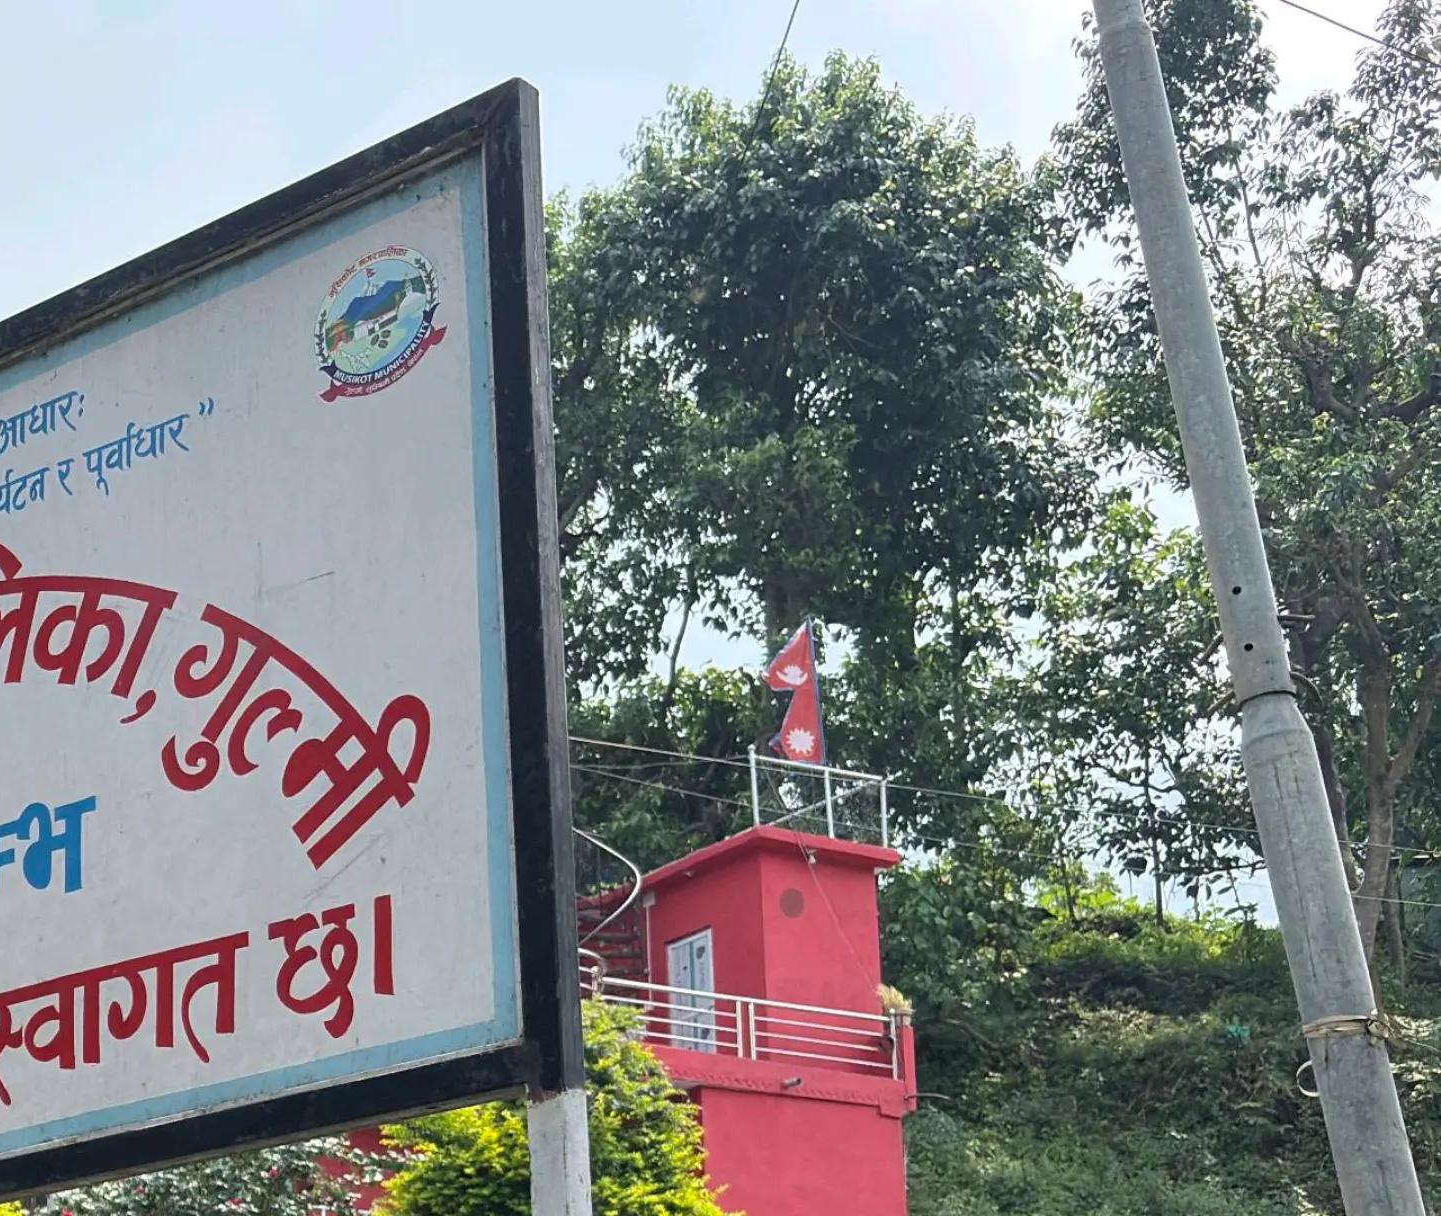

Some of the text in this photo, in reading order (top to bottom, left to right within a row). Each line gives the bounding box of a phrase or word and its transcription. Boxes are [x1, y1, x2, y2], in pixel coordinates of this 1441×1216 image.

[334, 369, 373, 385] MUSIKOT
[374, 321, 430, 381] MUNICIPALITY
[56, 458, 75, 496] र
[161, 603, 432, 870] गुल्मी
